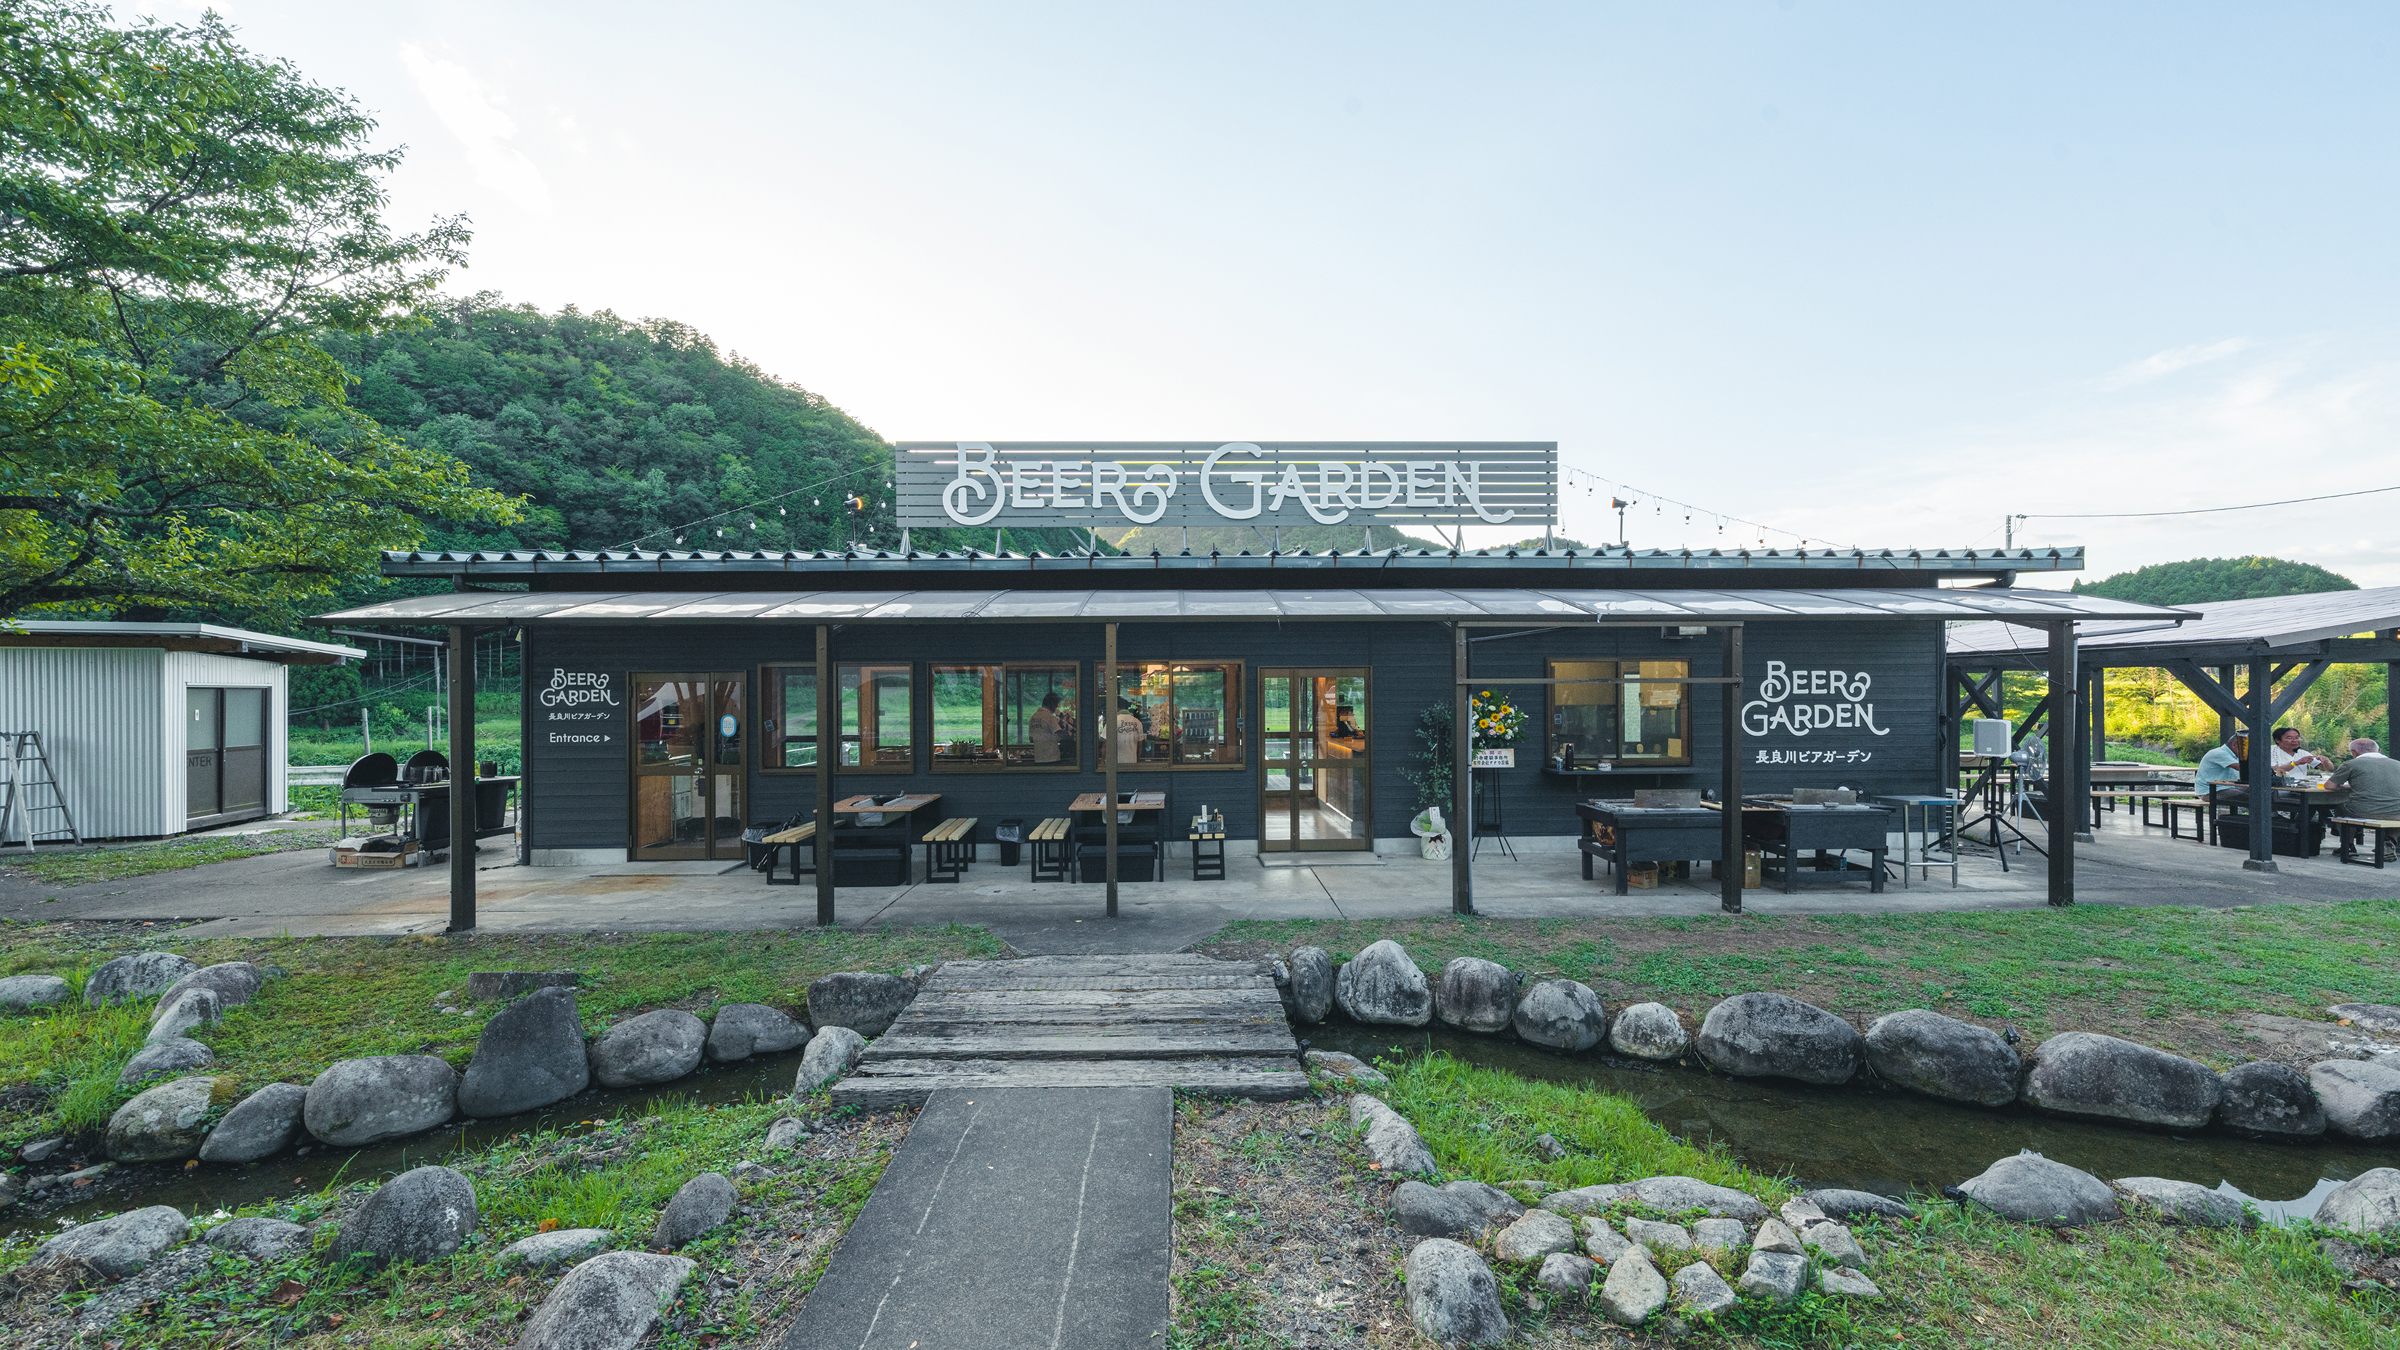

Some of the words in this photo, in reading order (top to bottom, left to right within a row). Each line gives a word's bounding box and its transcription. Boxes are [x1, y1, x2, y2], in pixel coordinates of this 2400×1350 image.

[942, 442, 1177, 525] BEER
[1200, 442, 1515, 525] GARDEN
[551, 668, 610, 690] BEER
[1760, 660, 1871, 702] BEER
[540, 688, 620, 707] GARDEN
[548, 712, 610, 720] 長良川ビアガーデン
[1741, 700, 1890, 736] GARDEN
[549, 732, 600, 743] Entrance
[186, 756, 212, 768] NTER
[1755, 750, 1872, 764] 長良川ビアガーデン
